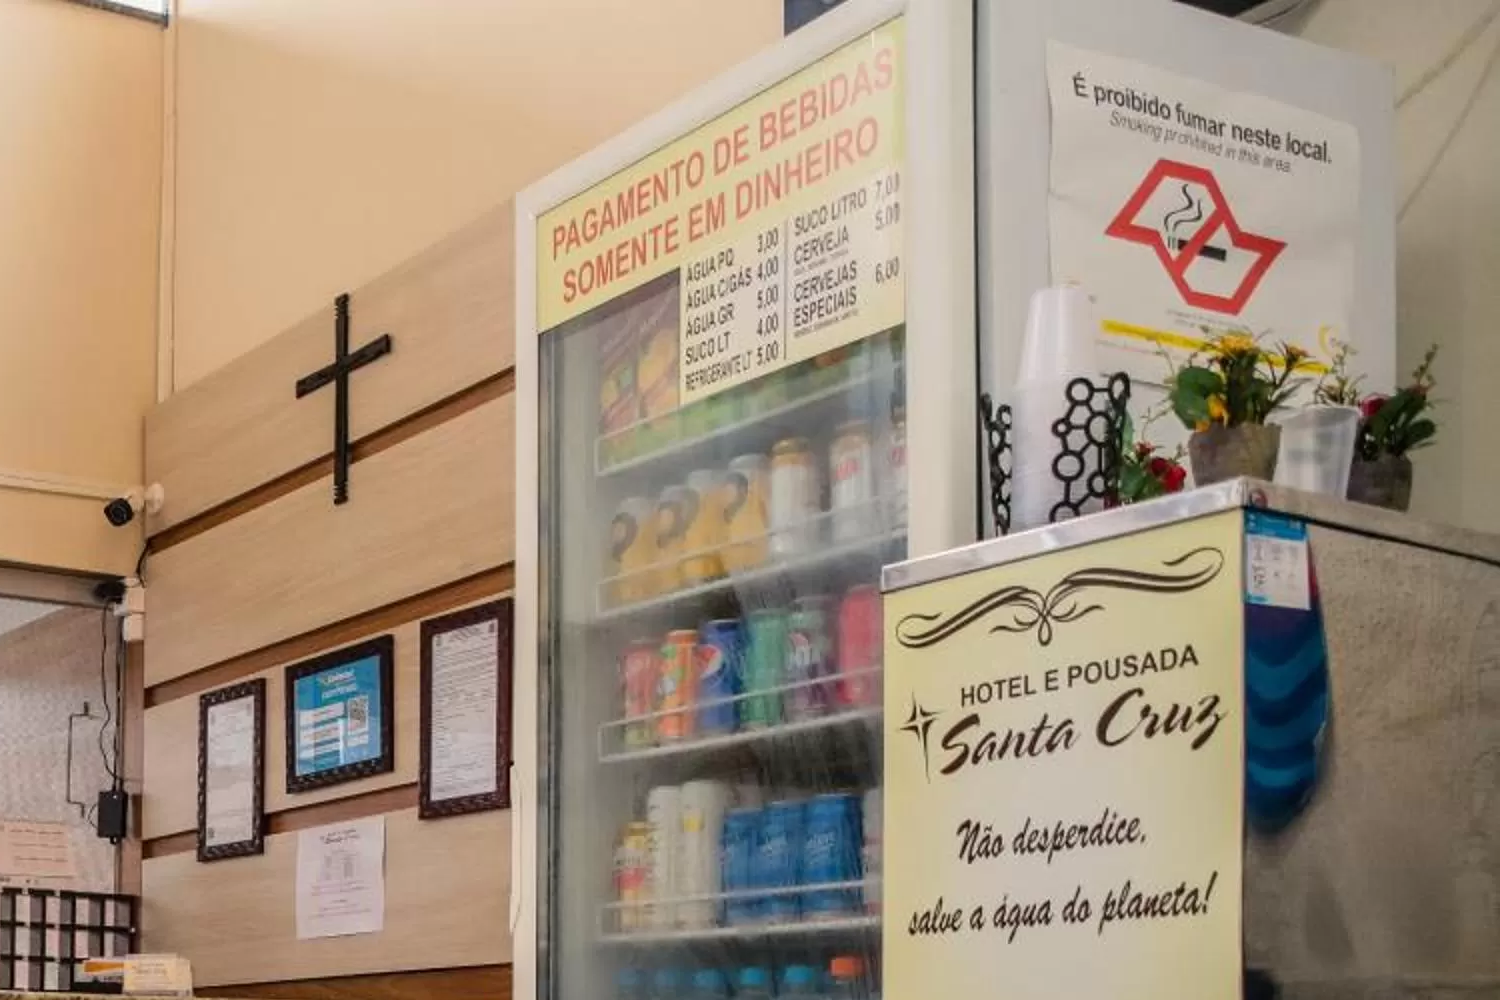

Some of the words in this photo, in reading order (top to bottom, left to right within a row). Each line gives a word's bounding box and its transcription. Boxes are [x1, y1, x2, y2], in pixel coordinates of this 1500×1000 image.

[1073, 71, 1089, 98] É
[1094, 81, 1171, 121] proibido
[1176, 102, 1227, 138] fumar
[1231, 125, 1281, 153] neste
[1286, 131, 1332, 164] local.
[1109, 110, 1162, 142] Smoking
[552, 151, 705, 261] PAGAMENTO
[713, 125, 750, 177] DE
[760, 47, 893, 152] BEBIDAS
[563, 217, 680, 304] SOMENTE
[688, 191, 726, 243] EM
[736, 117, 880, 220] DINHEIRO
[794, 205, 828, 236] SUCO
[831, 188, 867, 221] LITRO
[757, 228, 779, 253] 3,00
[794, 224, 849, 265] CERVEJA
[756, 255, 779, 281] 4,00
[793, 260, 857, 303] CERVEJAS
[793, 285, 857, 328] ESPECIAIS
[875, 256, 900, 284] 6,00
[756, 283, 779, 309] 5,00
[685, 337, 715, 366] SUCO
[717, 331, 731, 353] LT
[756, 312, 779, 337] 4,00
[685, 355, 741, 392] REFRIGERANTE
[756, 340, 779, 366] 5,00
[961, 674, 1037, 707] HOTEL
[1045, 669, 1059, 692] E
[1067, 644, 1198, 689] POUSADA
[940, 712, 1079, 775] Santa
[1096, 687, 1229, 750] Cruz
[956, 818, 1004, 865] Não
[1012, 808, 1148, 865] desperdice,
[907, 897, 962, 938] salve
[969, 905, 985, 930] a
[993, 896, 1054, 945] água
[1062, 886, 1093, 926] do
[1098, 871, 1218, 937] planeta!
